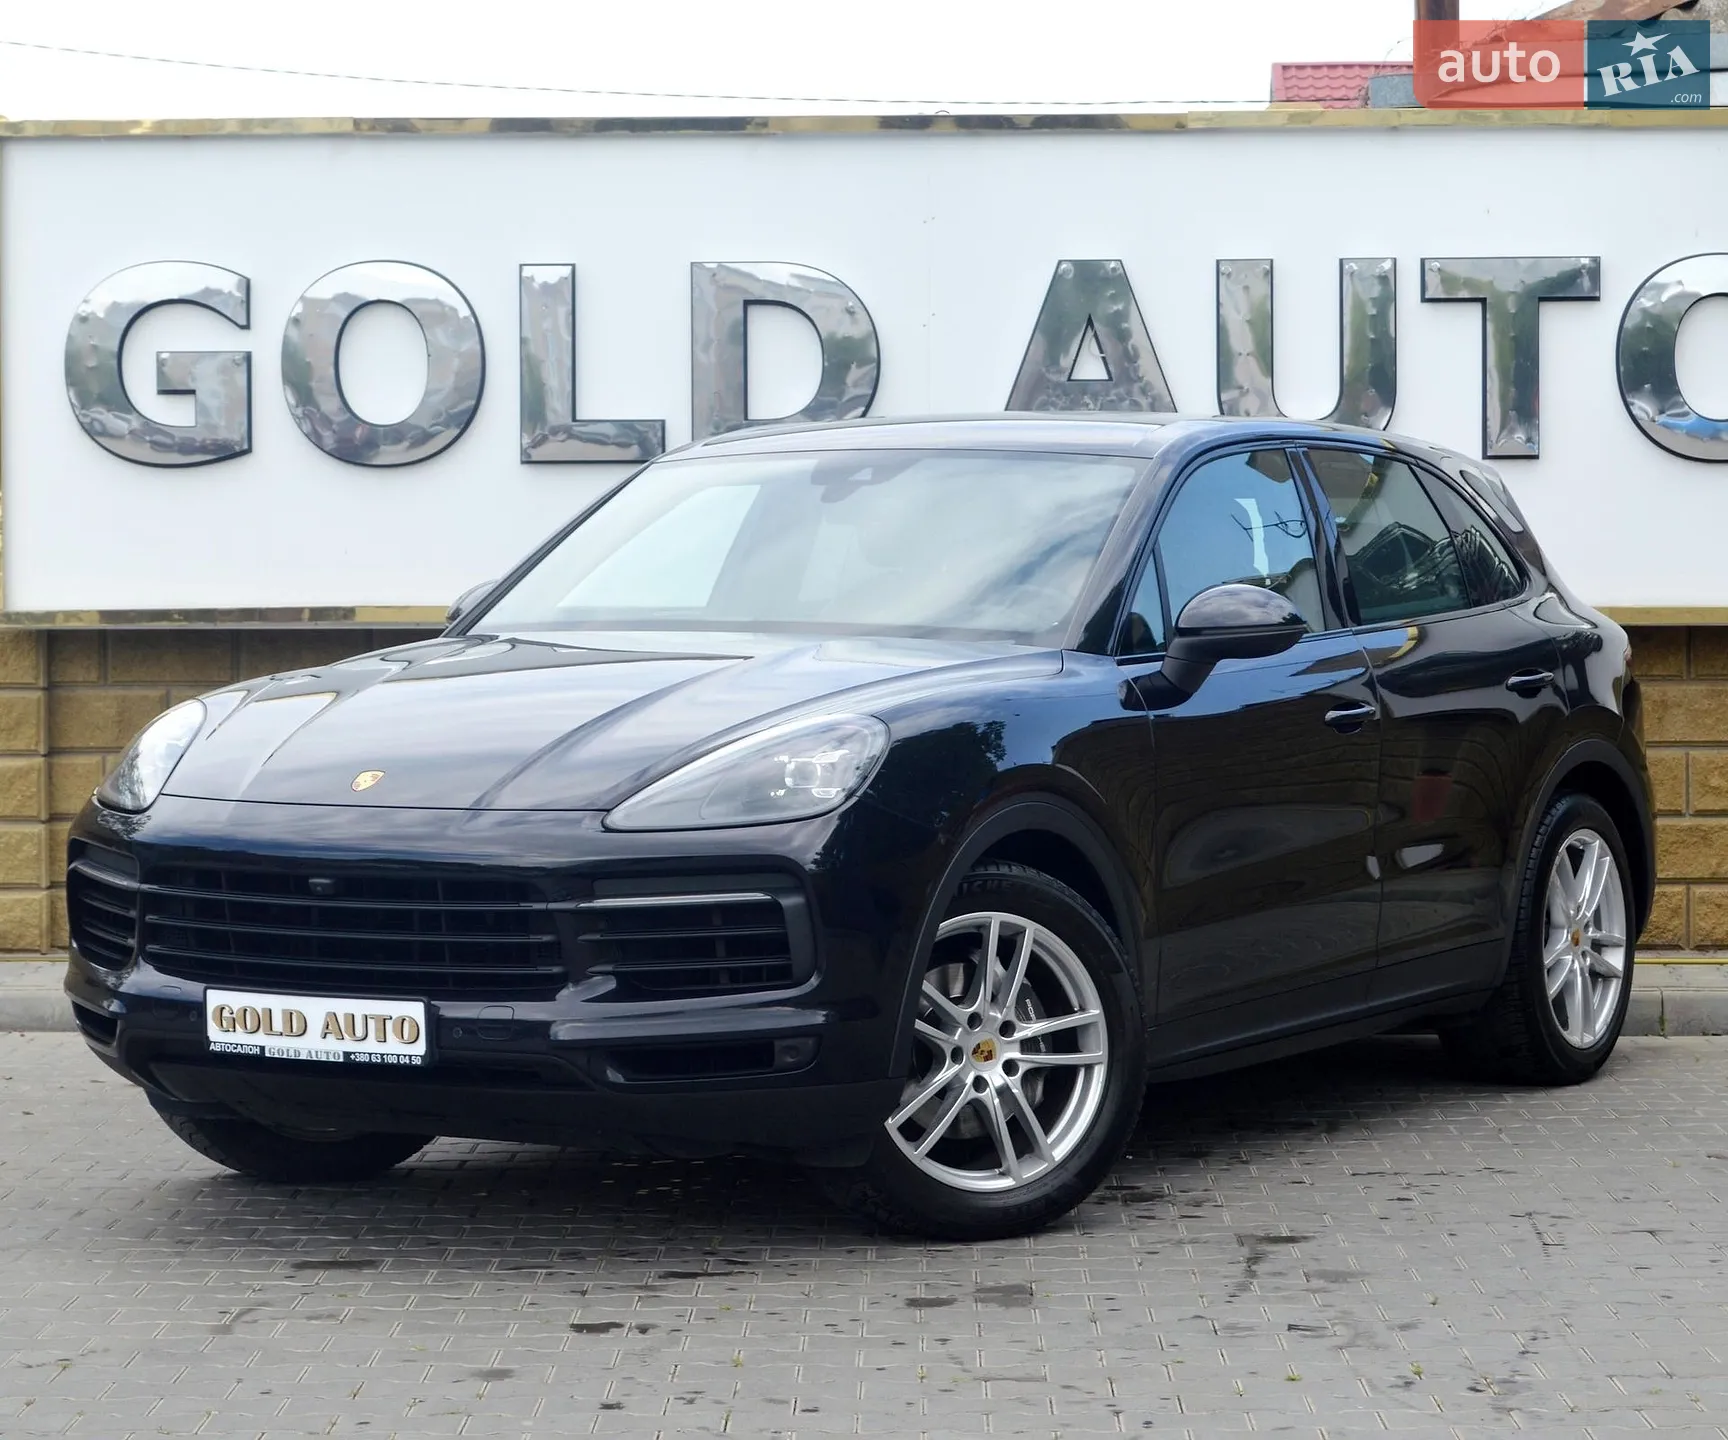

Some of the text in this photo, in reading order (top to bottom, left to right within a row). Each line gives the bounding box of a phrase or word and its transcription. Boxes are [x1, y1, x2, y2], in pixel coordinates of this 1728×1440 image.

[64, 253, 1728, 468] GOLD AUTO
[211, 1003, 420, 1045] GOLD AUTO
[209, 1042, 422, 1065] АВТОСАЛОН GOLD AUTO +380 63 100 04 50
